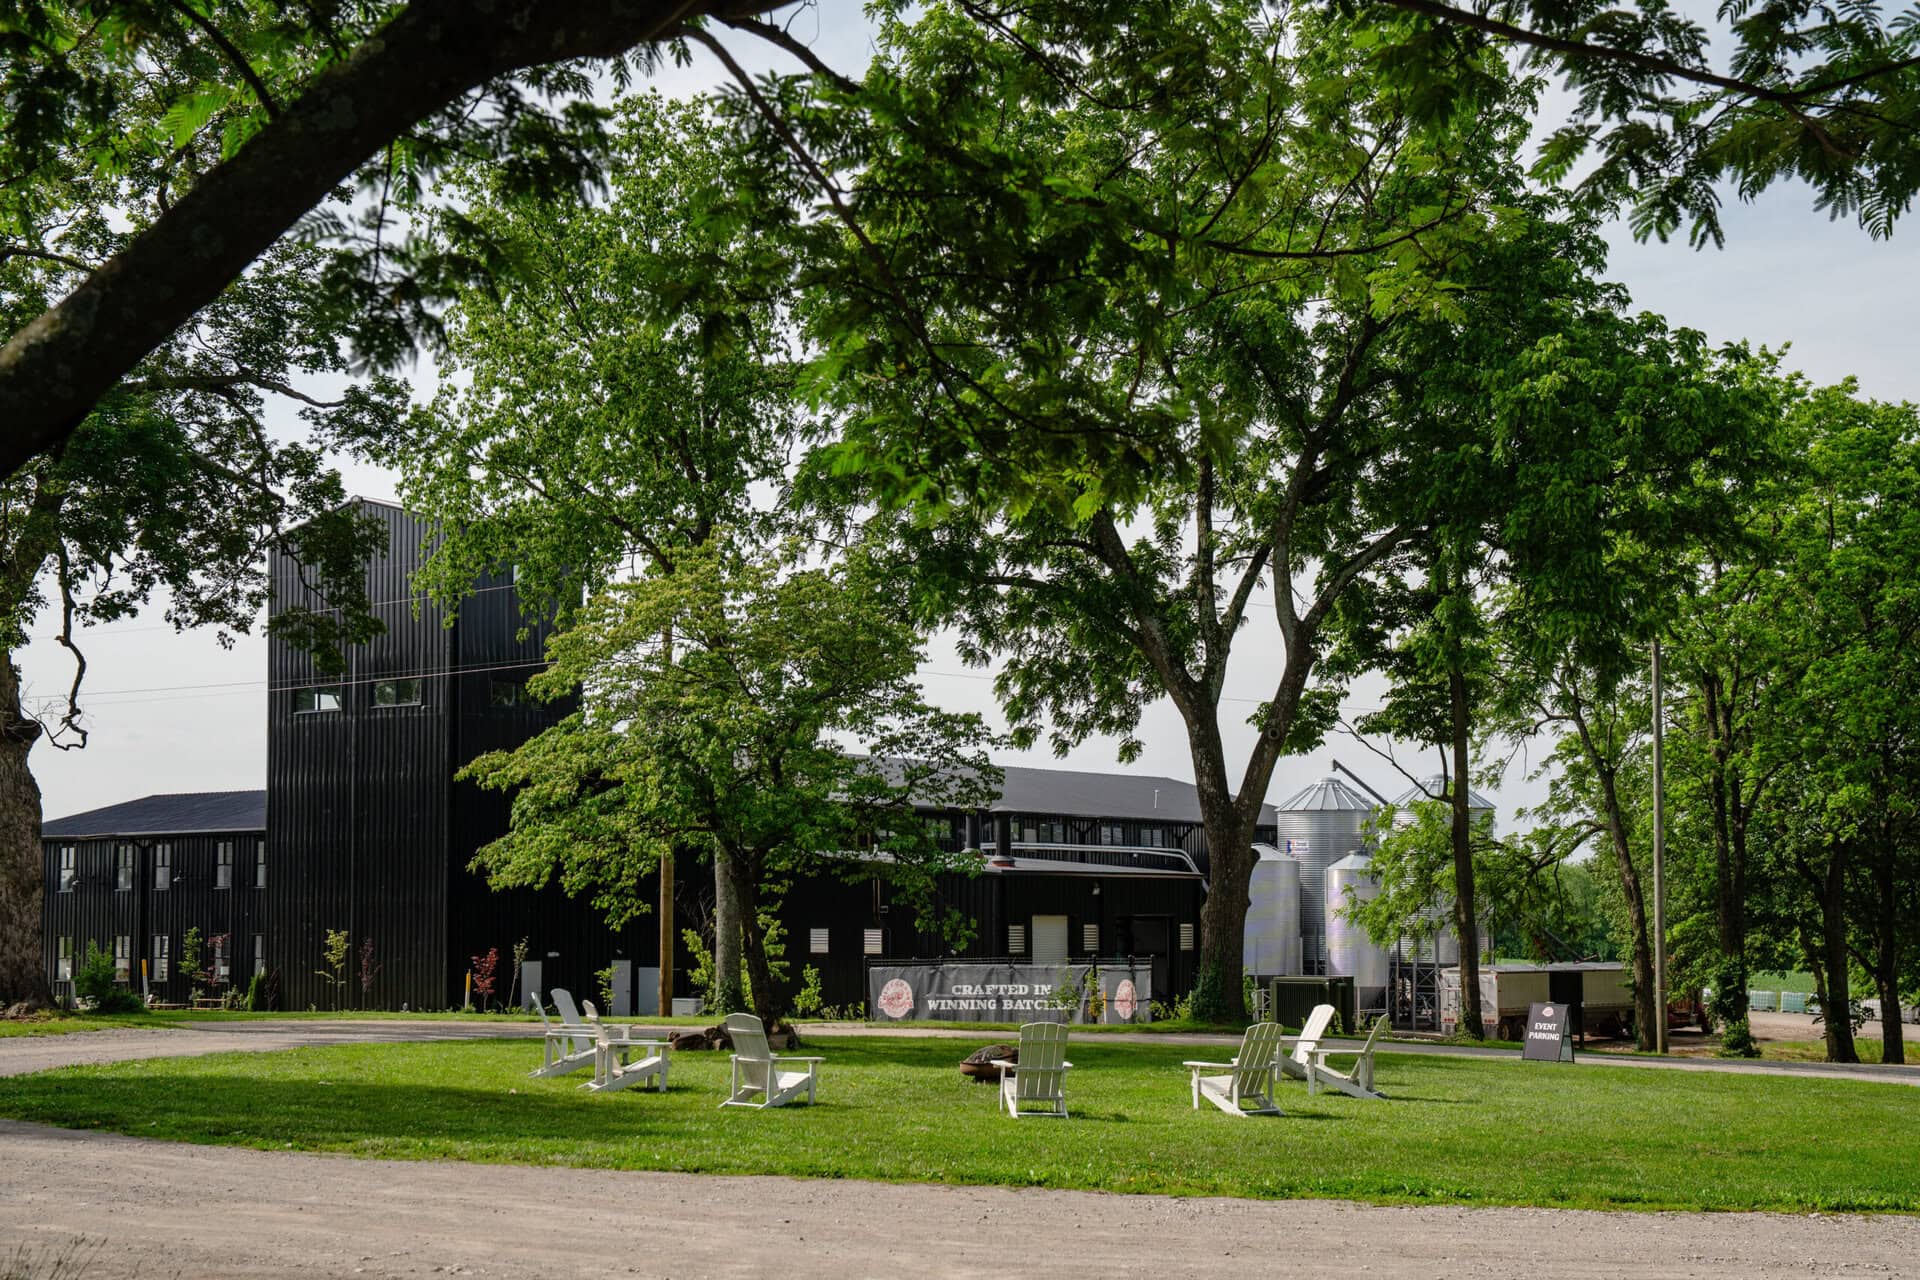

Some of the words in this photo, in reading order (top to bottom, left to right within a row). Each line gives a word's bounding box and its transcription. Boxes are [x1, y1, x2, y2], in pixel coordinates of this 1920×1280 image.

[951, 984, 1028, 995] CRAFTED
[1033, 984, 1052, 995] IN
[927, 999, 997, 1010] WINNING
[1534, 1022, 1557, 1031] EVENT
[1528, 1031, 1560, 1041] PARKING
